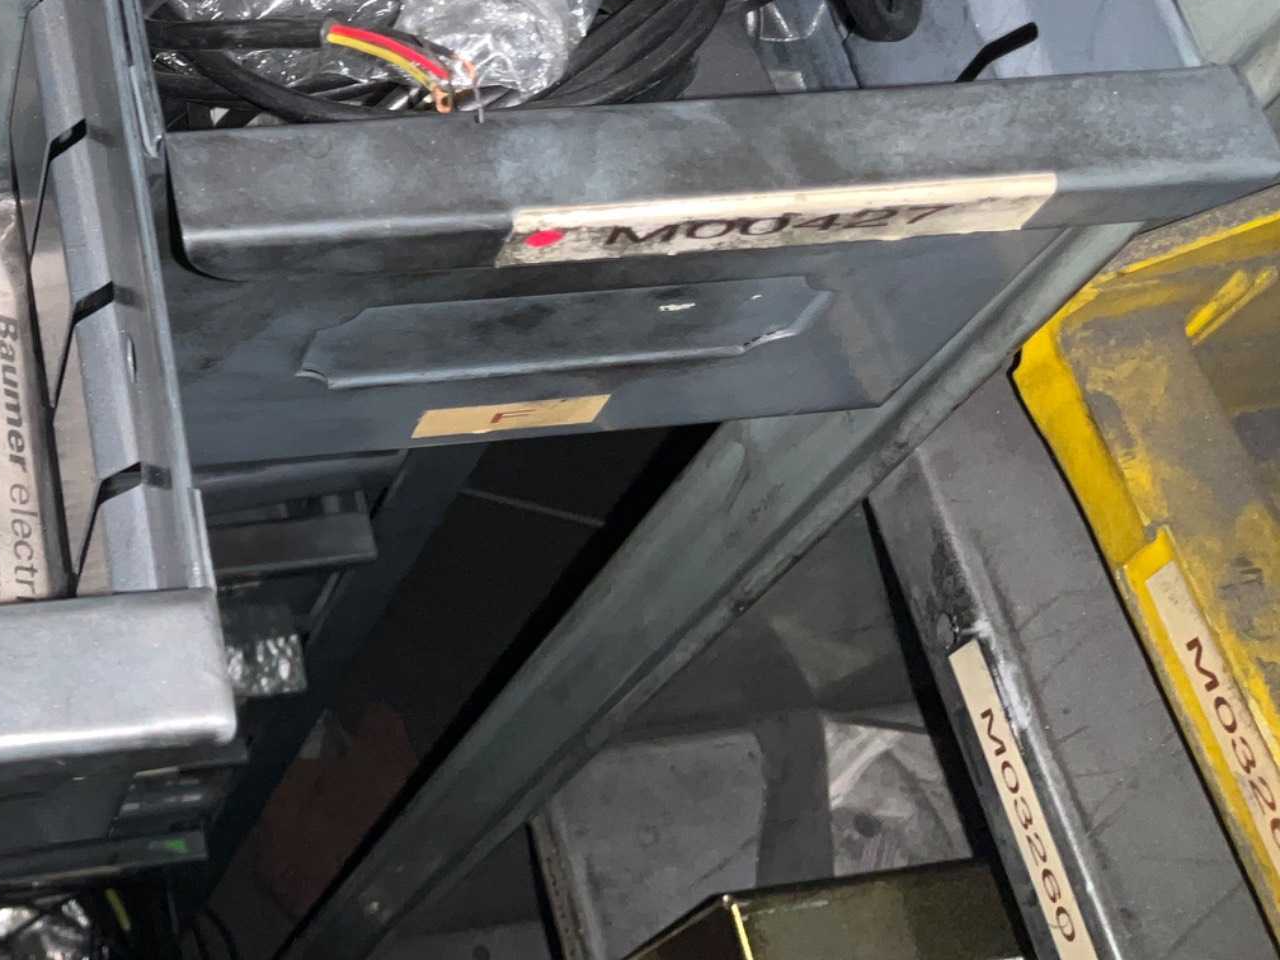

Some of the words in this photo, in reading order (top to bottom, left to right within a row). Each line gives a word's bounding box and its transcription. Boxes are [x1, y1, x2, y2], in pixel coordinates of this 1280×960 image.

[607, 204, 955, 245] M00427
[489, 408, 536, 424] F
[981, 708, 1076, 943] M03260
